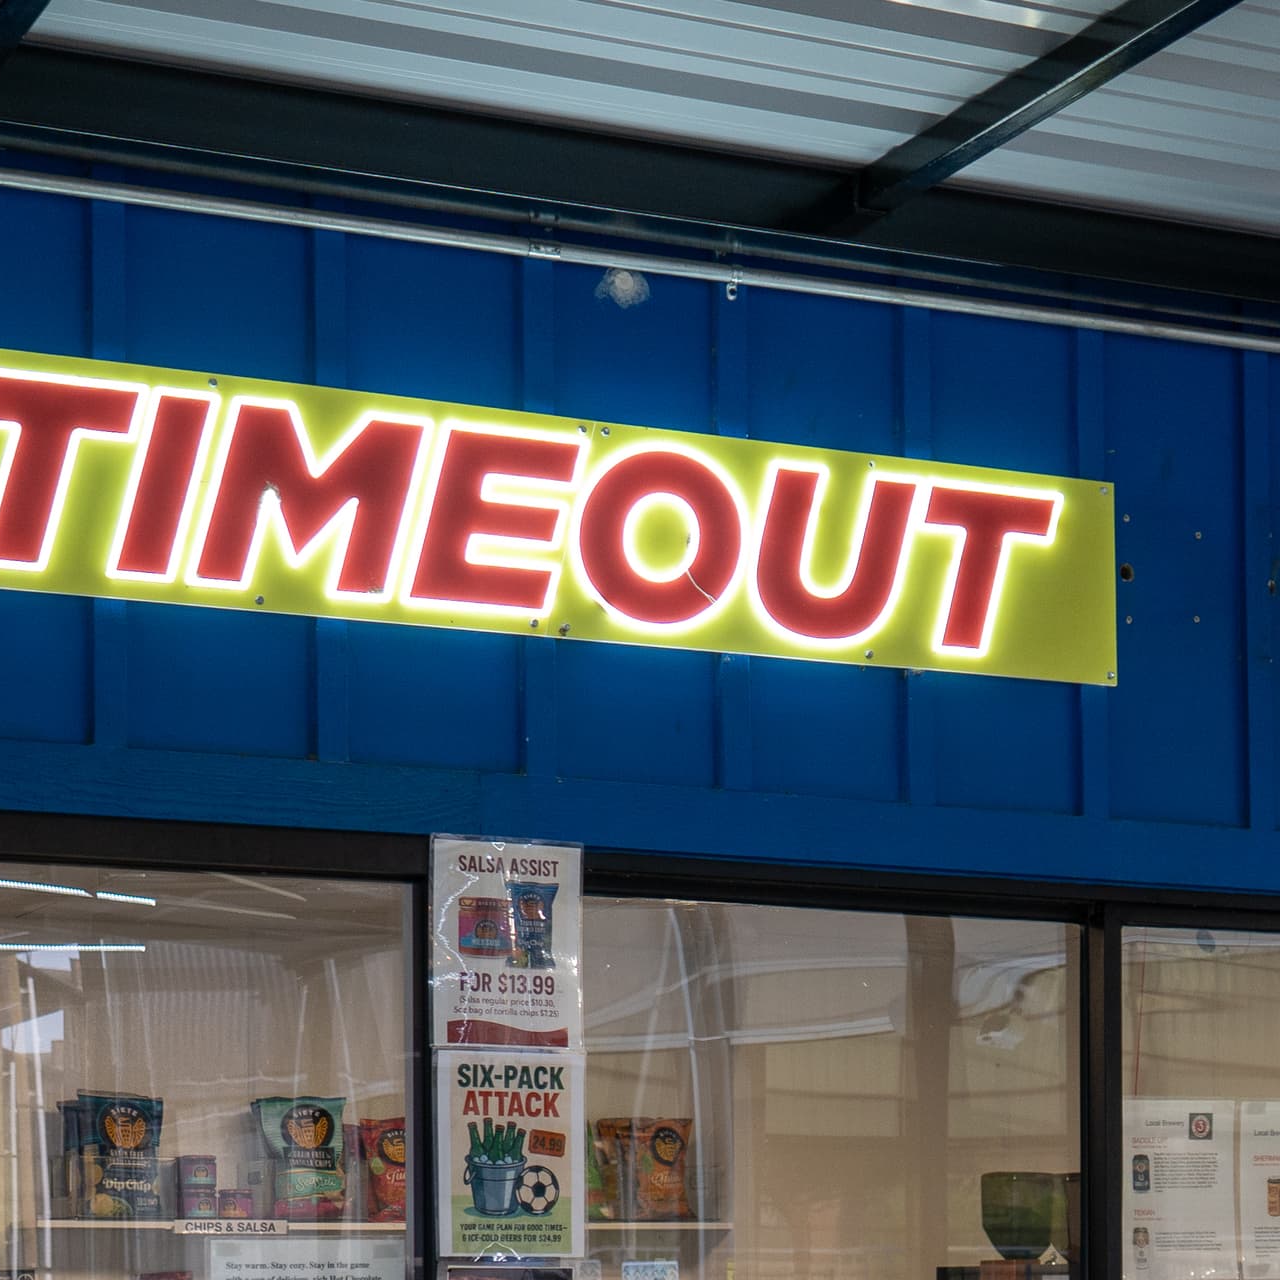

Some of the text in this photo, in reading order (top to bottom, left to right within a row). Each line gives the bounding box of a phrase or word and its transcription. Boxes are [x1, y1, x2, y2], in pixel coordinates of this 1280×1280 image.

[458, 854, 558, 877] SALSA ASSIST
[460, 972, 554, 995] FOR $13.99
[458, 1064, 564, 1090] SIX-PACK
[463, 1090, 560, 1117] ATTACK
[185, 1222, 276, 1232] CHIPS & SALSA
[226, 1262, 242, 1270] Stay
[271, 1262, 287, 1270] Stay
[309, 1262, 325, 1270] Stay
